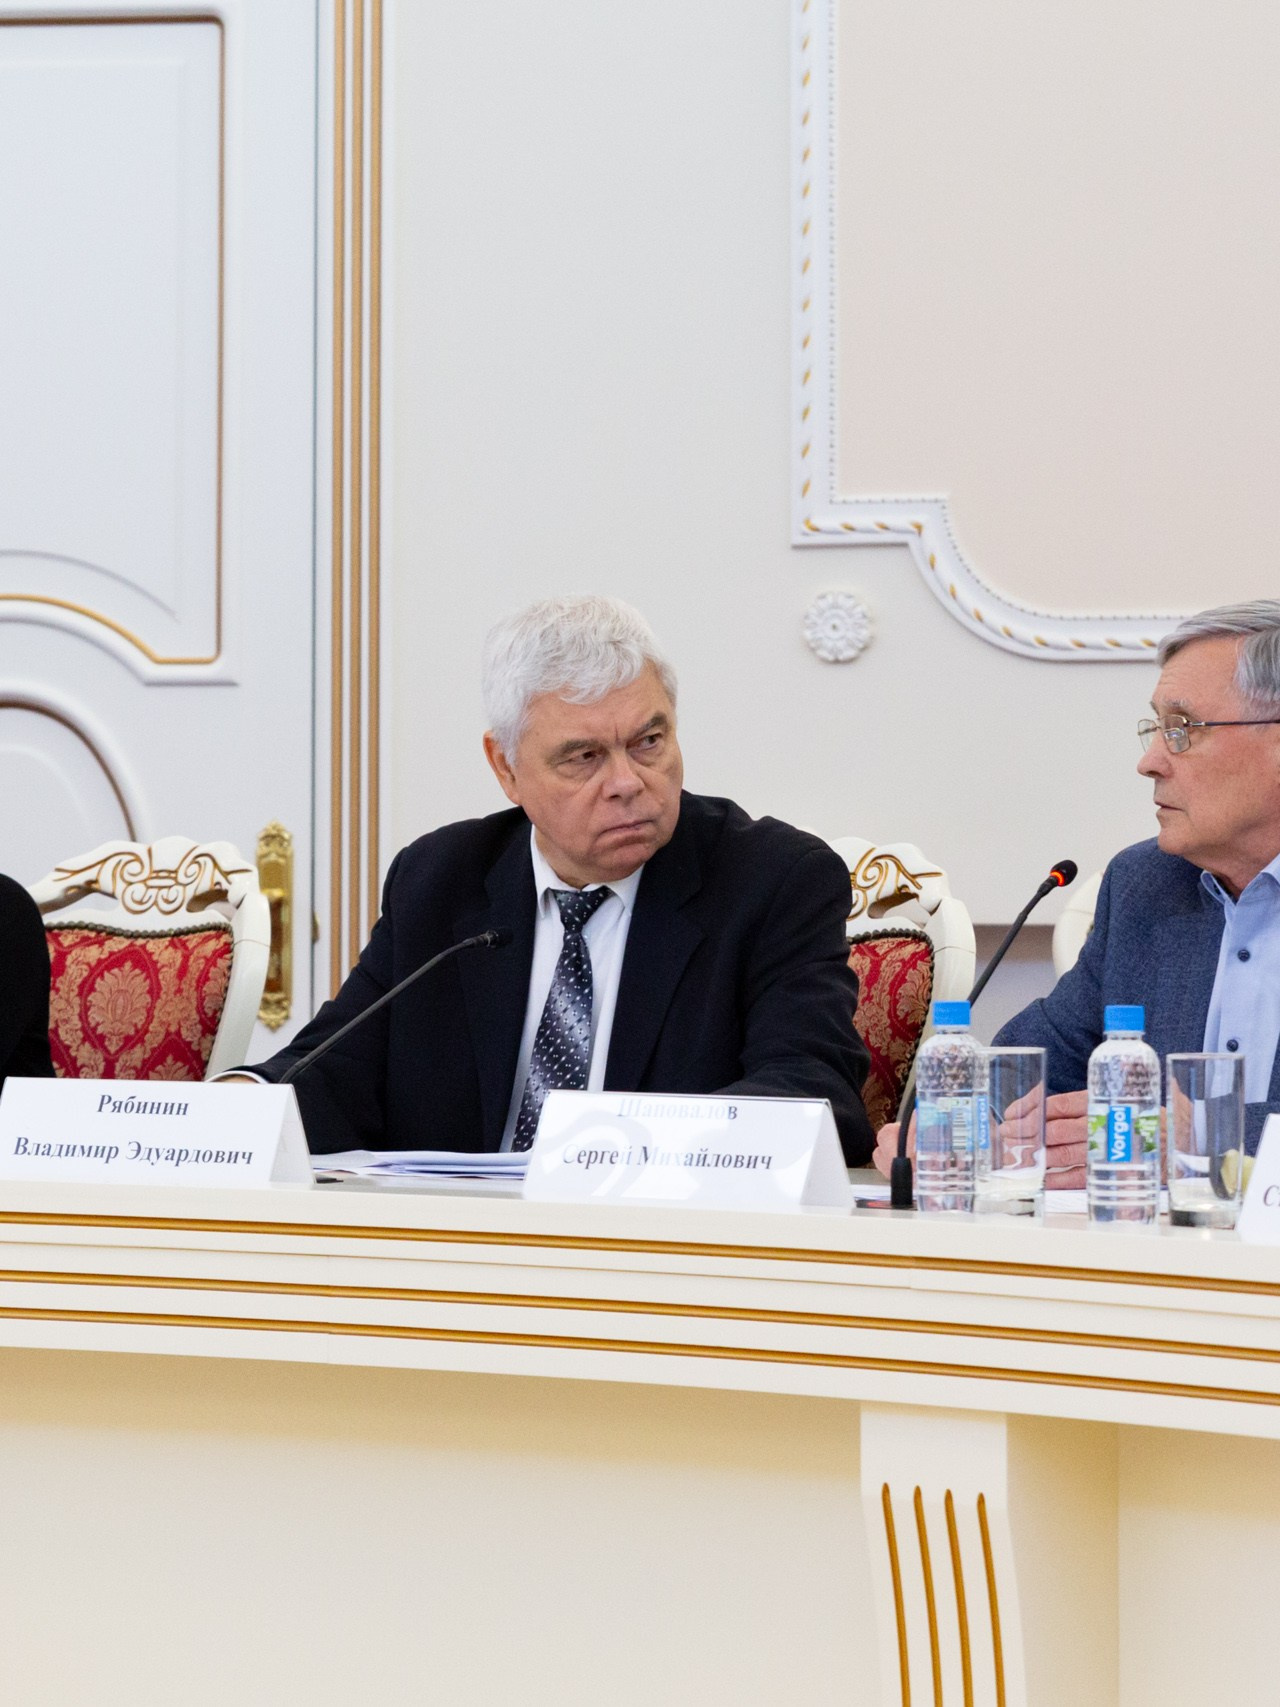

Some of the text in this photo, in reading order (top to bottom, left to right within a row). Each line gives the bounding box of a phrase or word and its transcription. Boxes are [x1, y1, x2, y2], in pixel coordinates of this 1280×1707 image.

[97, 1094, 189, 1116] Рябинин
[1110, 1106, 1131, 1161] Vorgol
[14, 1136, 253, 1166] Владимир Эдуардович
